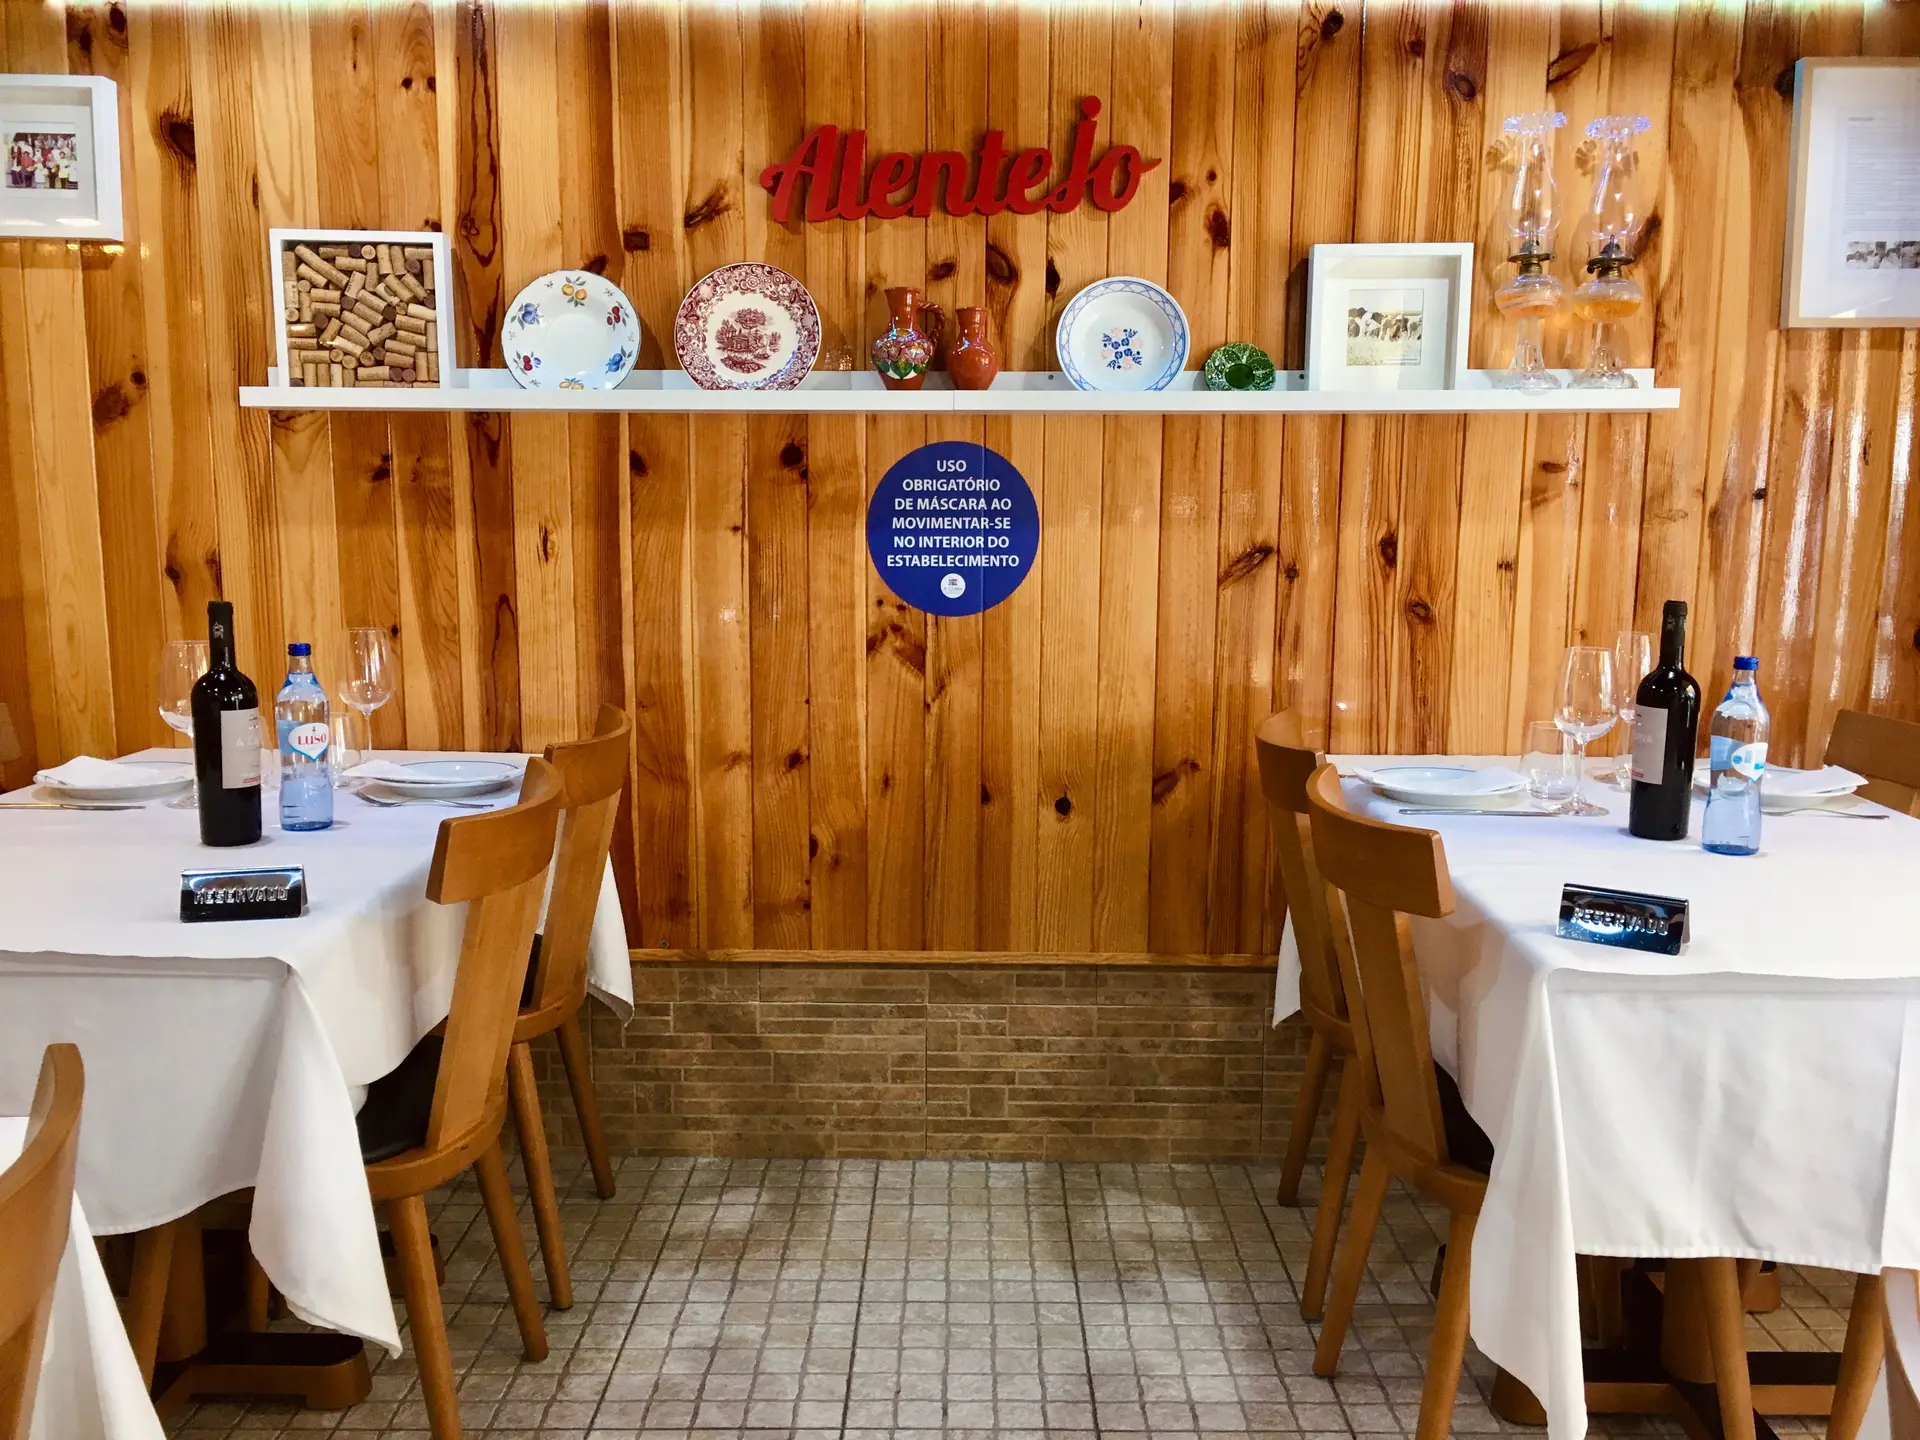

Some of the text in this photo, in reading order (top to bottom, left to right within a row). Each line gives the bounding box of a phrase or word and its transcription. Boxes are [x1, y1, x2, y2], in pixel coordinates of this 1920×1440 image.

[760, 95, 1162, 222] Alentejo
[937, 460, 966, 472] USO
[903, 477, 1000, 491] OBRIGATÓRIO
[895, 496, 1011, 510] DE MÁSCARA AO
[893, 517, 1010, 529] MOVIMENTAR-SE
[894, 536, 1009, 548] NO INTERIOR DO
[887, 555, 1019, 566] ESTABELECIMENTO
[297, 733, 327, 745] LUSO
[193, 885, 290, 905] RESERVADO
[1571, 906, 1669, 937] RESERVADO
